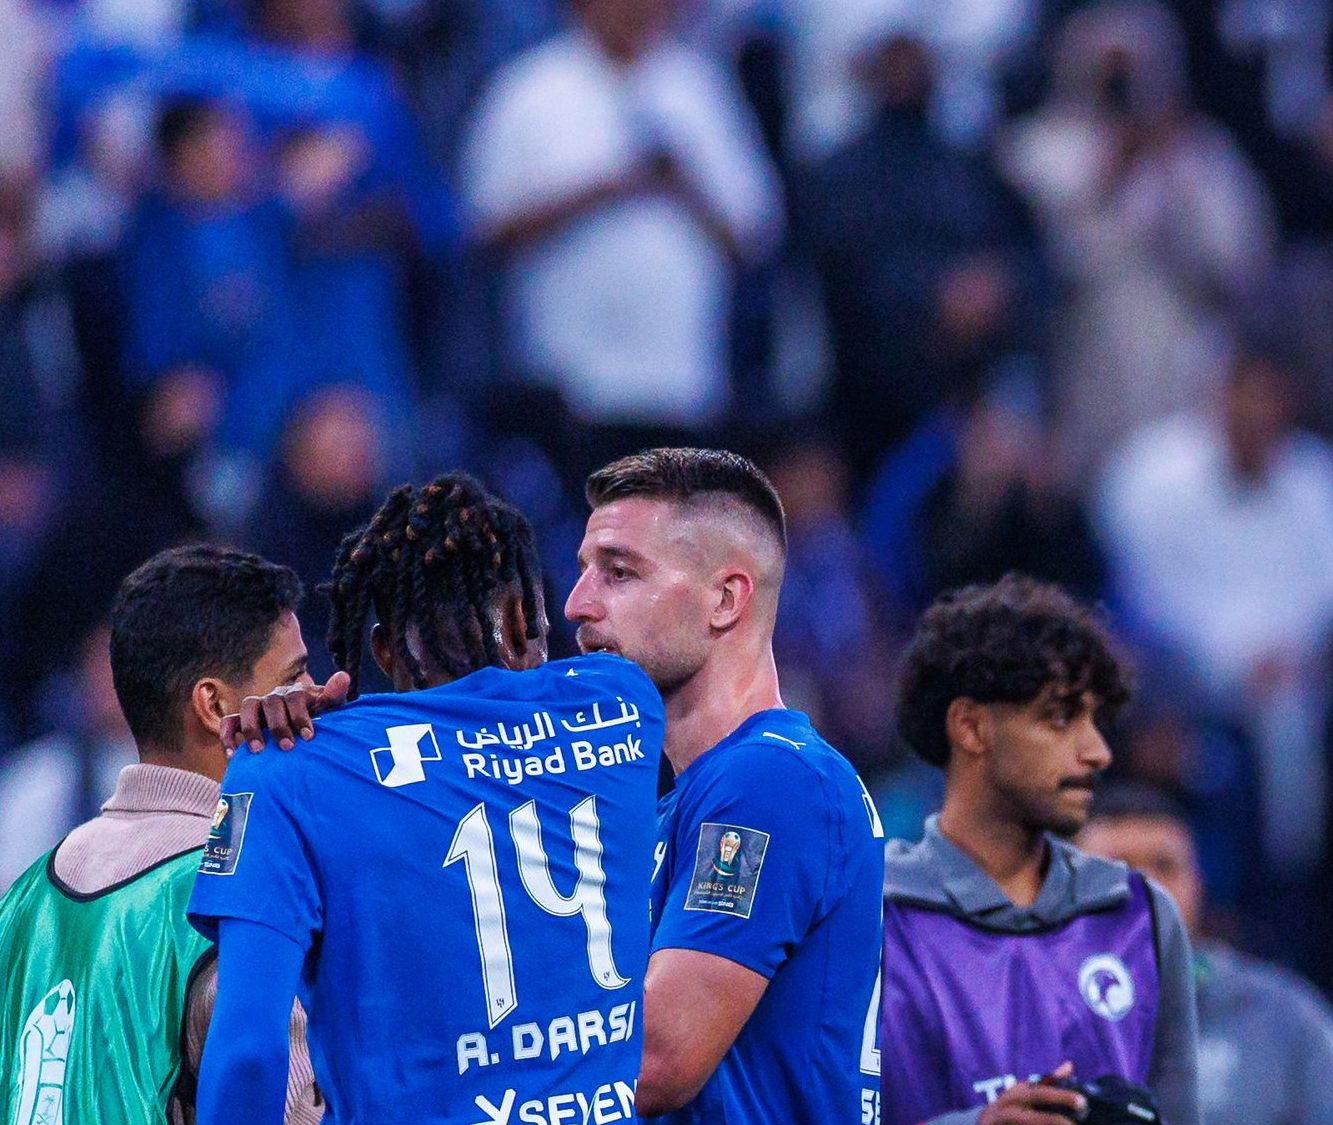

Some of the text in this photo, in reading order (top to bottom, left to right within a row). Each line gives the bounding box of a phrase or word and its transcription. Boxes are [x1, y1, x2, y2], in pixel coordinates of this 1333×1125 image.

[456, 711, 556, 750] الرياض
[462, 733, 645, 785] Riyad Bank
[443, 795, 632, 1030] 14
[456, 1032, 500, 1075] A.
